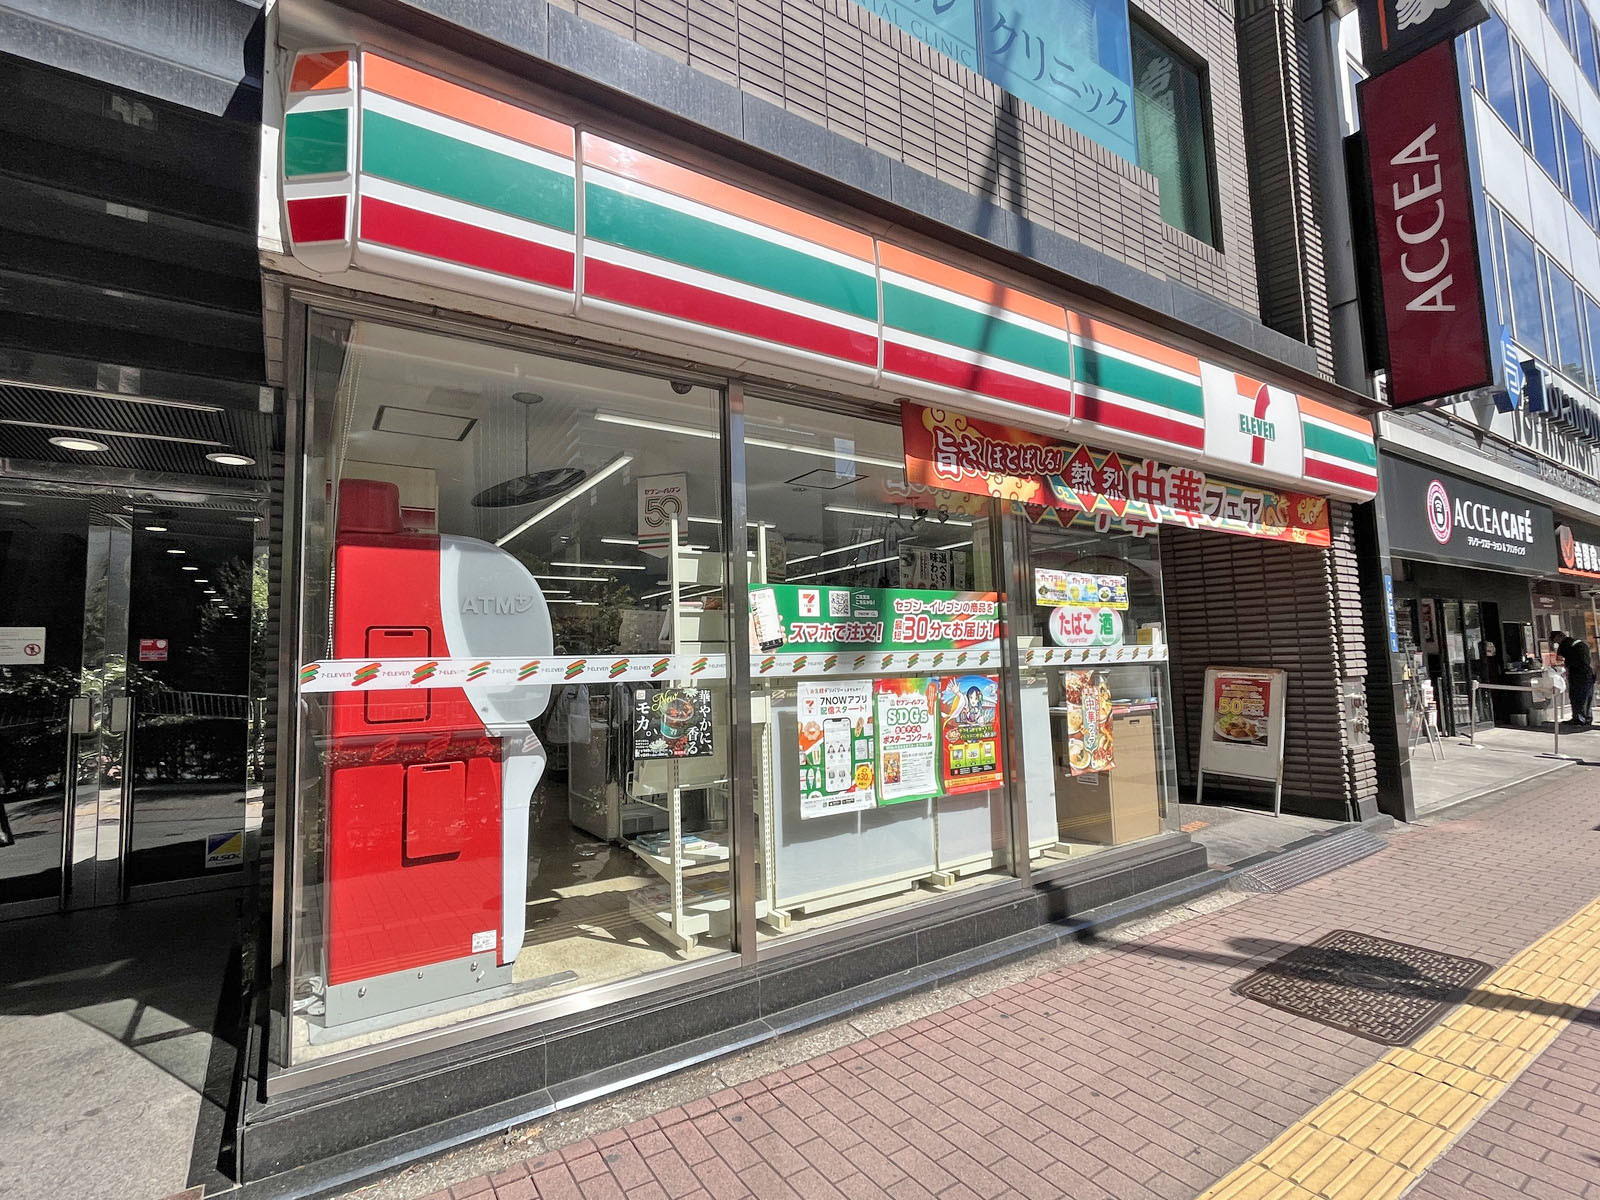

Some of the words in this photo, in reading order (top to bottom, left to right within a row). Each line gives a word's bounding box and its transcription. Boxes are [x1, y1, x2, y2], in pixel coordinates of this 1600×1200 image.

[910, 19, 972, 68] CLINIC
[990, 11, 1128, 126] クリニック
[1390, 122, 1457, 312] ACCEA
[644, 494, 683, 528] 50
[1454, 497, 1502, 537] ACCEA
[1501, 509, 1534, 544] CAFÉ
[461, 595, 519, 615] ATM
[789, 622, 883, 642] スマホで注文!
[1059, 612, 1093, 636] たばこ
[1099, 612, 1114, 636] 酒
[651, 689, 679, 711] New
[820, 695, 867, 706] 7NOWアプリ
[1218, 697, 1243, 715] 50
[635, 702, 652, 737] モカ。
[698, 689, 713, 750] 華やかに、
[887, 707, 929, 726] SDGs
[687, 726, 699, 755] 香る
[883, 732, 932, 744] ポスターコンクール
